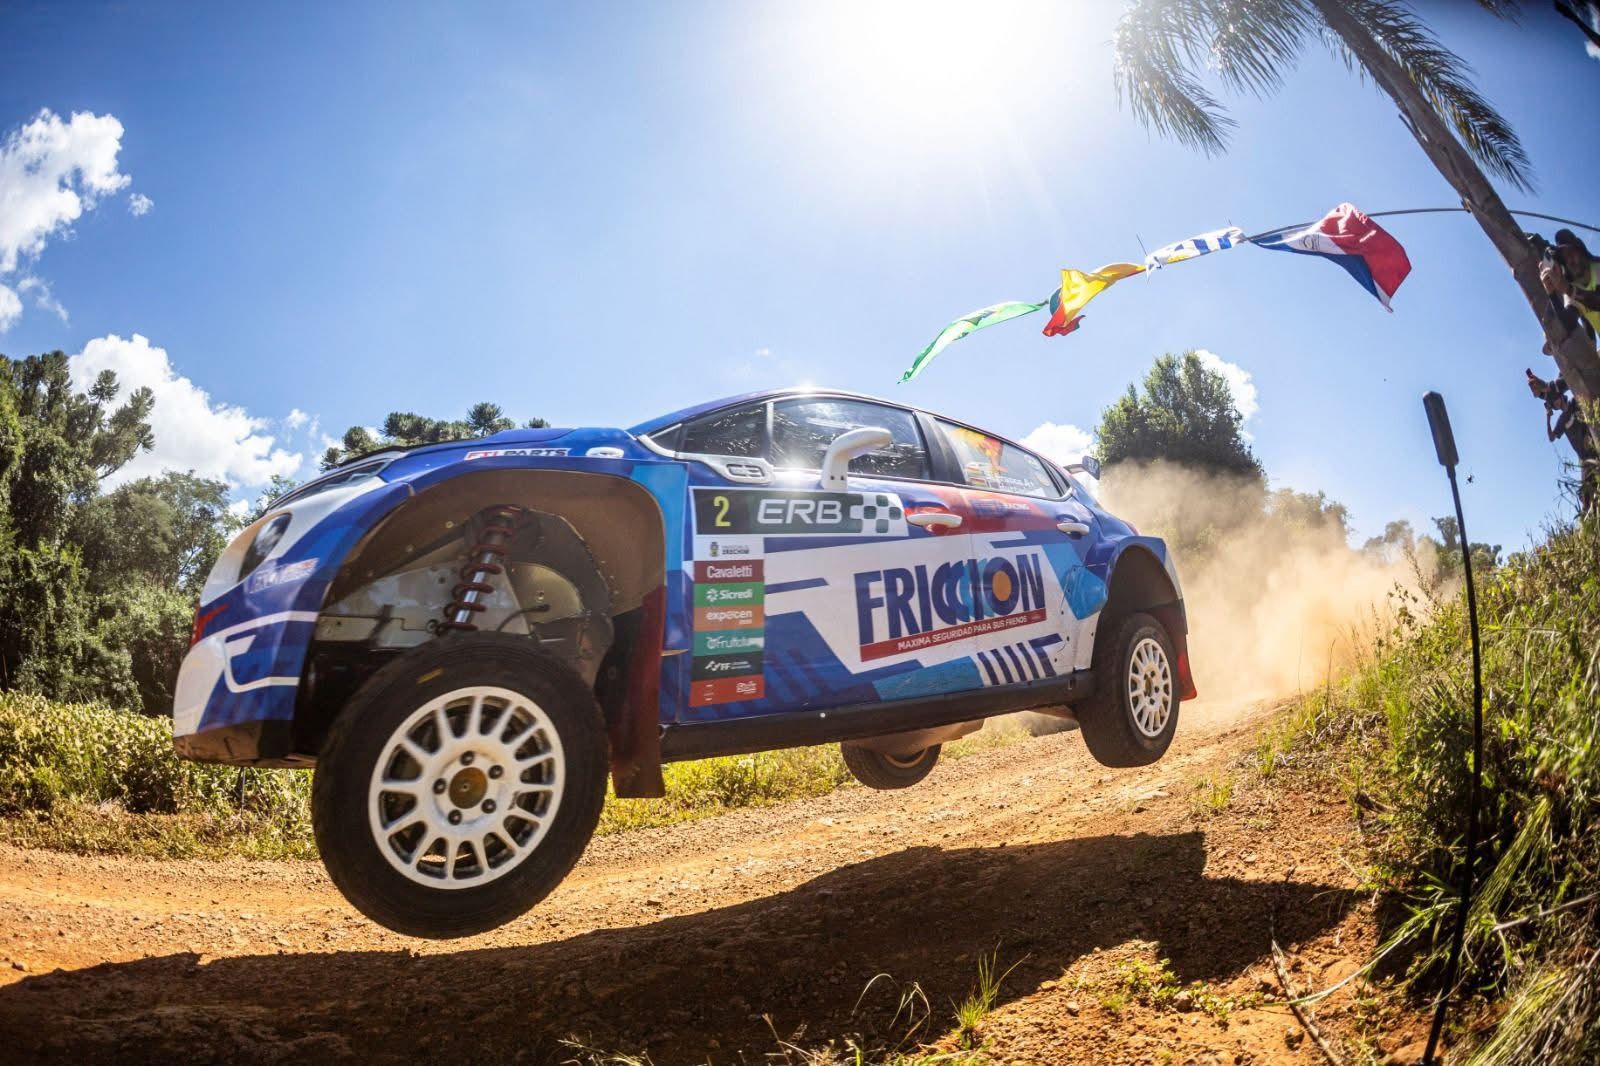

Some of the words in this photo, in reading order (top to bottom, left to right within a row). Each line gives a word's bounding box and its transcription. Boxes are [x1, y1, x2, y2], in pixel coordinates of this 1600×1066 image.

[713, 495, 731, 527] 2
[756, 498, 842, 525] ERB
[706, 564, 753, 578] Cavaletti
[719, 588, 753, 600] Sicredi
[853, 553, 1047, 646] FRICCION
[897, 635, 931, 651] MAXIMA
[932, 625, 974, 643] SEGURIDAD
[973, 622, 993, 634] PARA
[992, 619, 1006, 630] SUS
[1005, 615, 1028, 627] FRENOS
